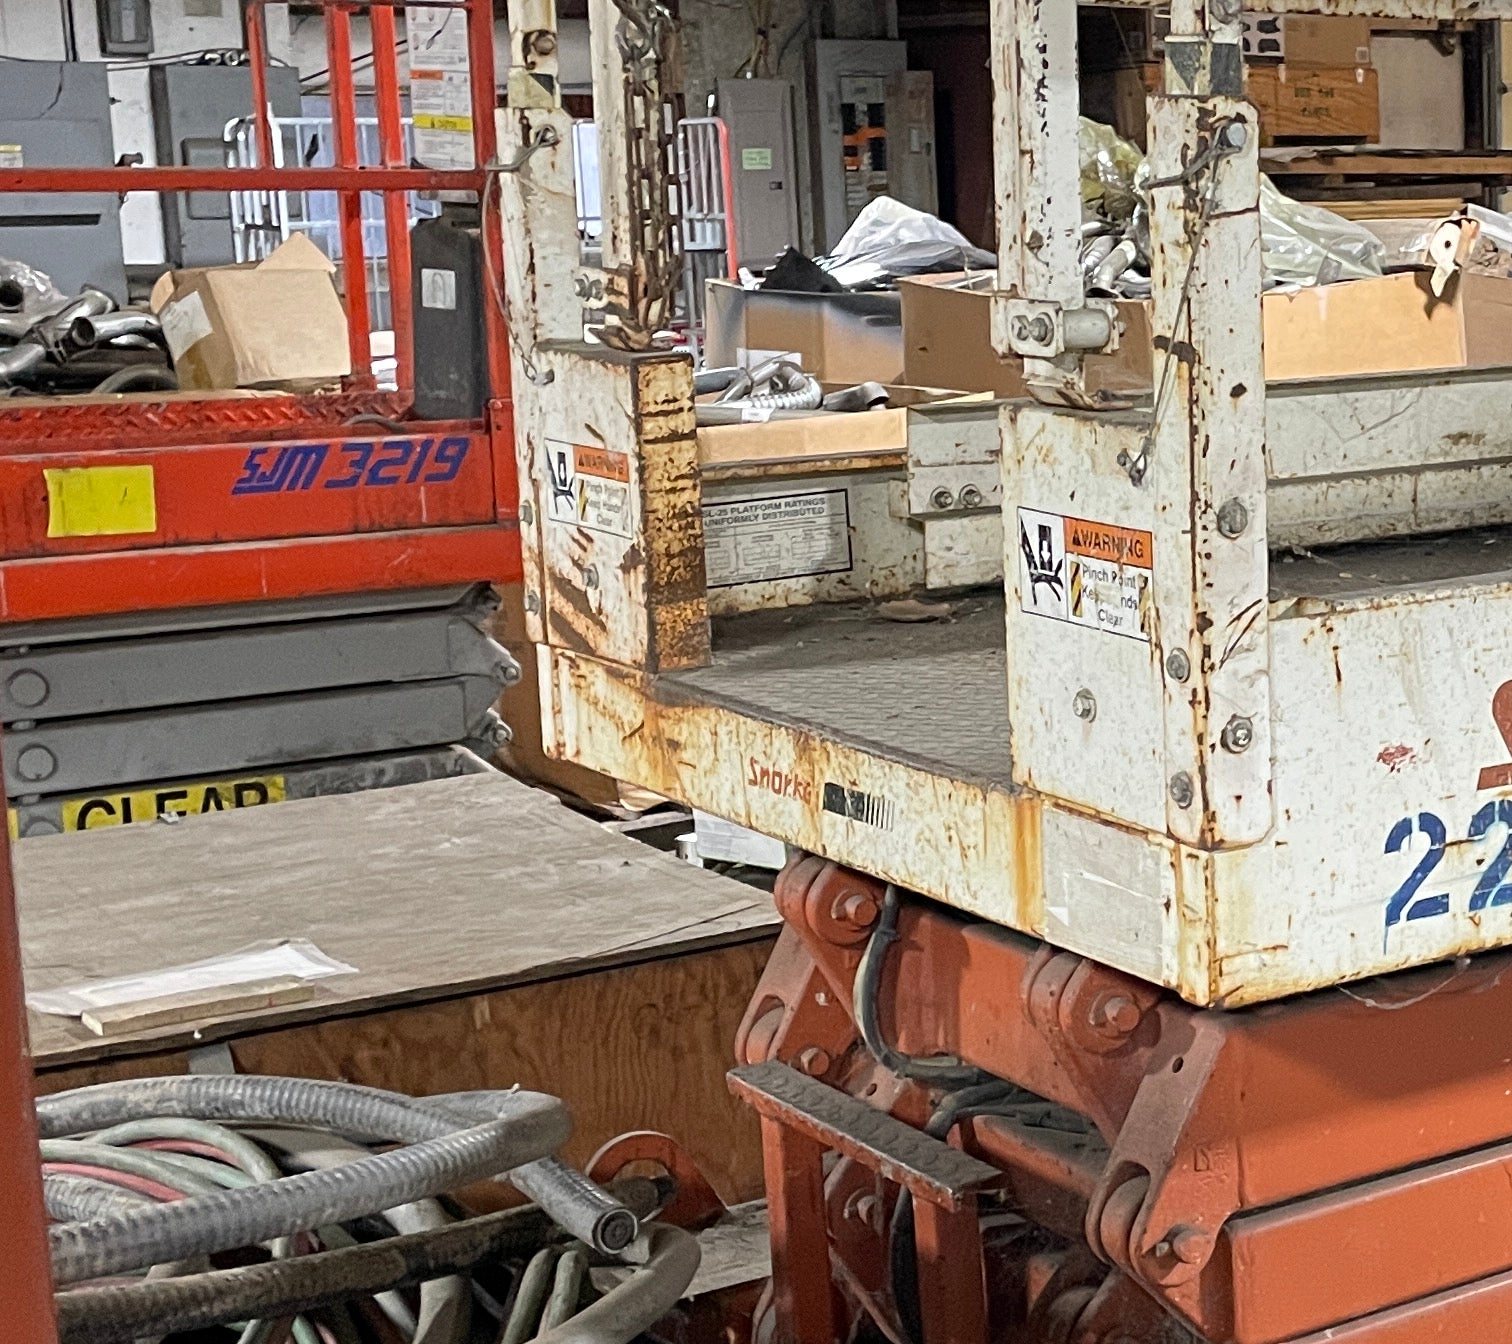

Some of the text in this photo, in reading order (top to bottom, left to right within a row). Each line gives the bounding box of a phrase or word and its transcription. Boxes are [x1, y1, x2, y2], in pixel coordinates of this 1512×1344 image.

[231, 436, 470, 496] SJM 3219
[704, 506, 825, 527] UNIFORMLY DISTRIBUTED
[730, 502, 782, 515] PLATFORM
[784, 497, 826, 508] RATINGS
[1081, 528, 1144, 560] WARNING
[1082, 563, 1109, 583] Pinch
[1098, 608, 1124, 627] Clear
[748, 755, 813, 806] Snorke
